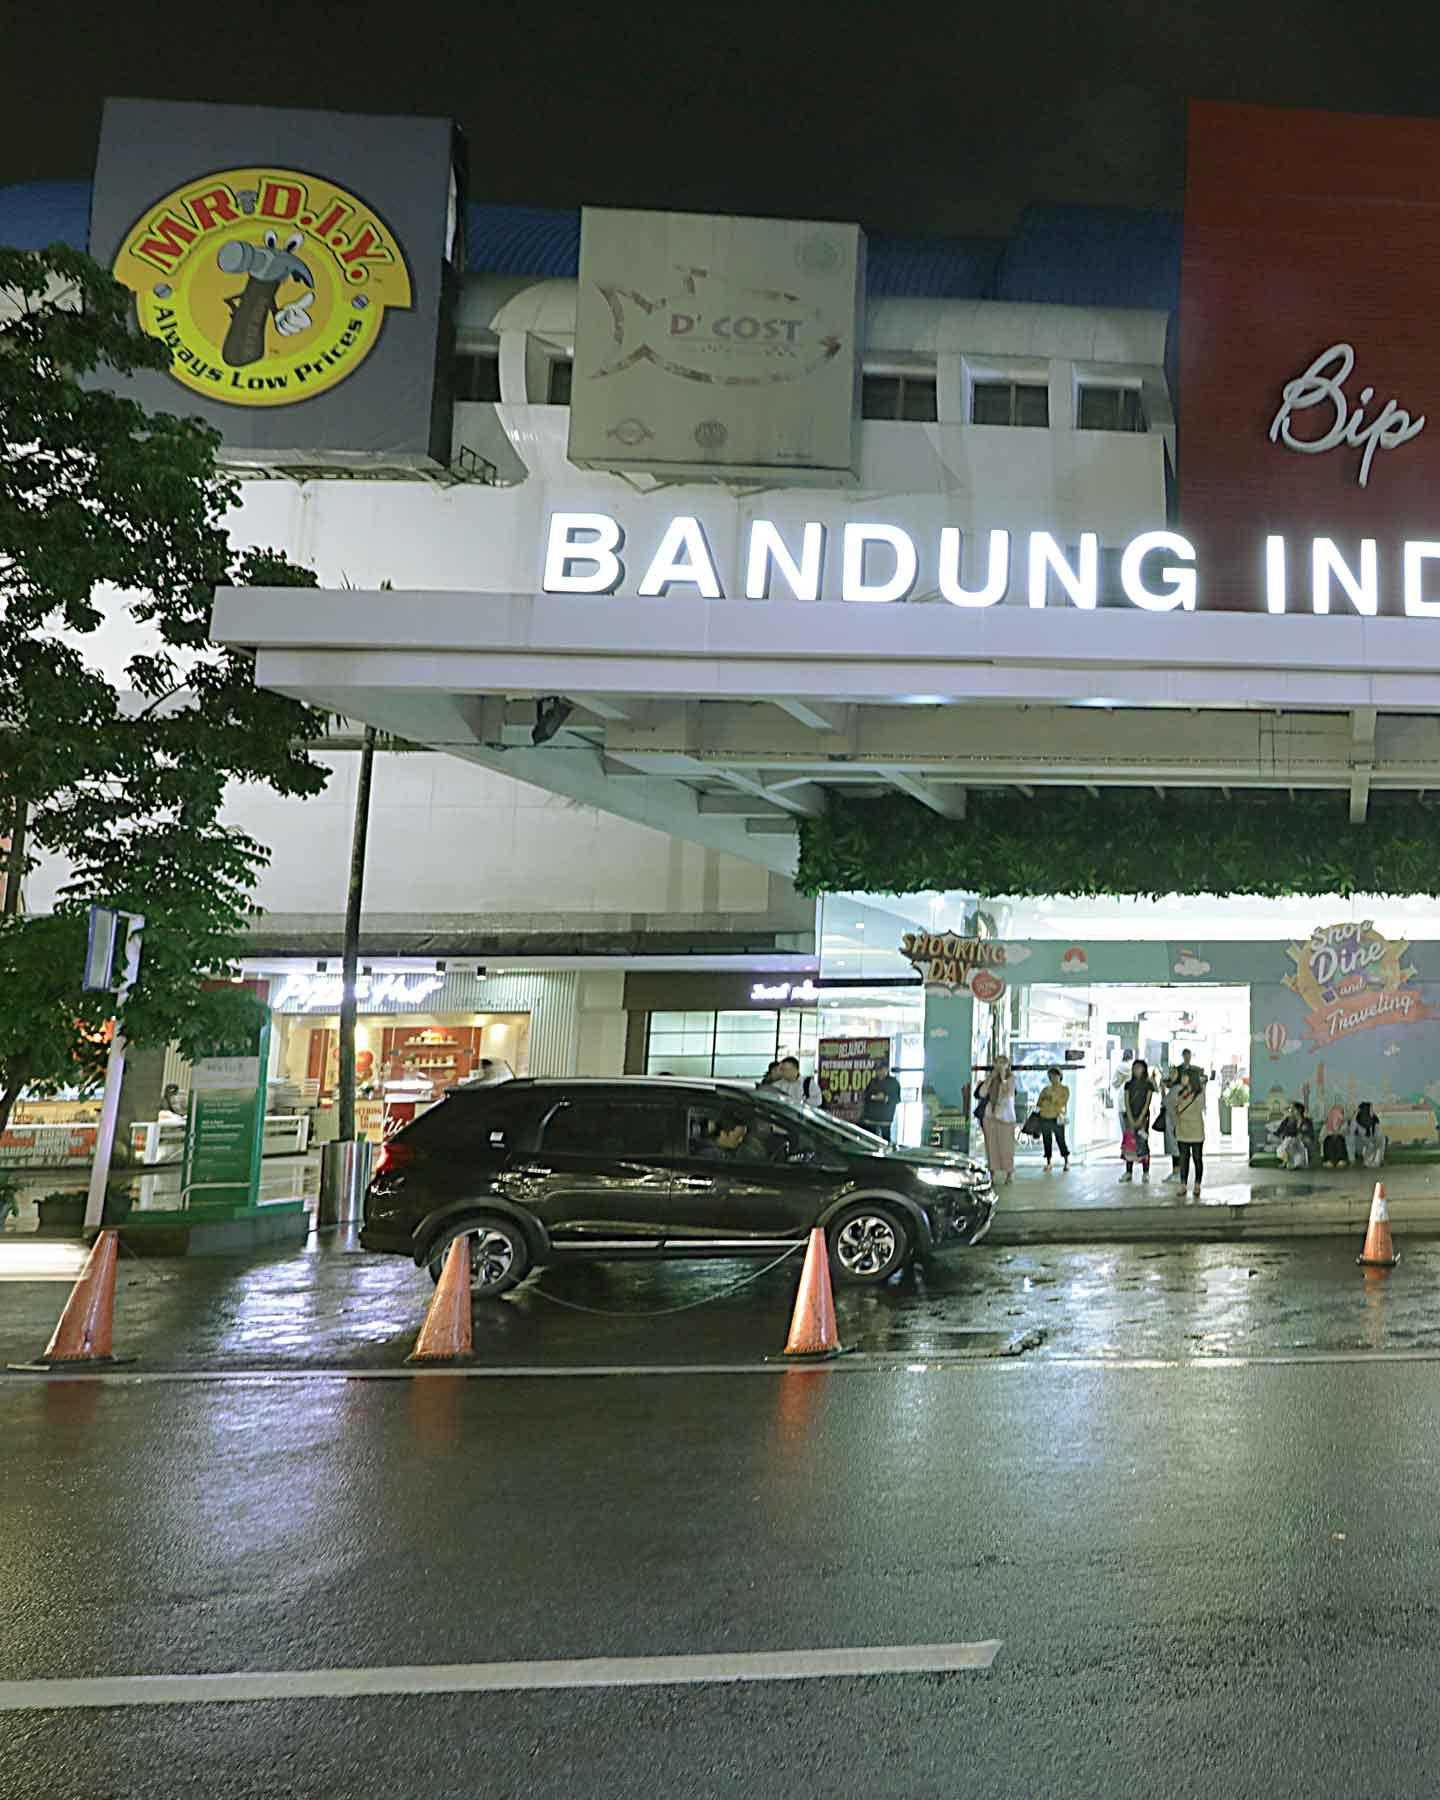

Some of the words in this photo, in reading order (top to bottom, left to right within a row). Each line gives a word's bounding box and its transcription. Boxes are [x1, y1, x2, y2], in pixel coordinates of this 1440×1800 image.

[154, 306, 224, 380] Always
[231, 375, 287, 389] Low
[294, 320, 362, 382] Prices
[1269, 344, 1425, 487] Bip
[542, 512, 1197, 610] BANDUNG
[902, 933, 1007, 965] SHOCKING
[1309, 942, 1385, 984] Dine
[928, 959, 970, 984] DAY
[1327, 992, 1414, 1036] Traveling
